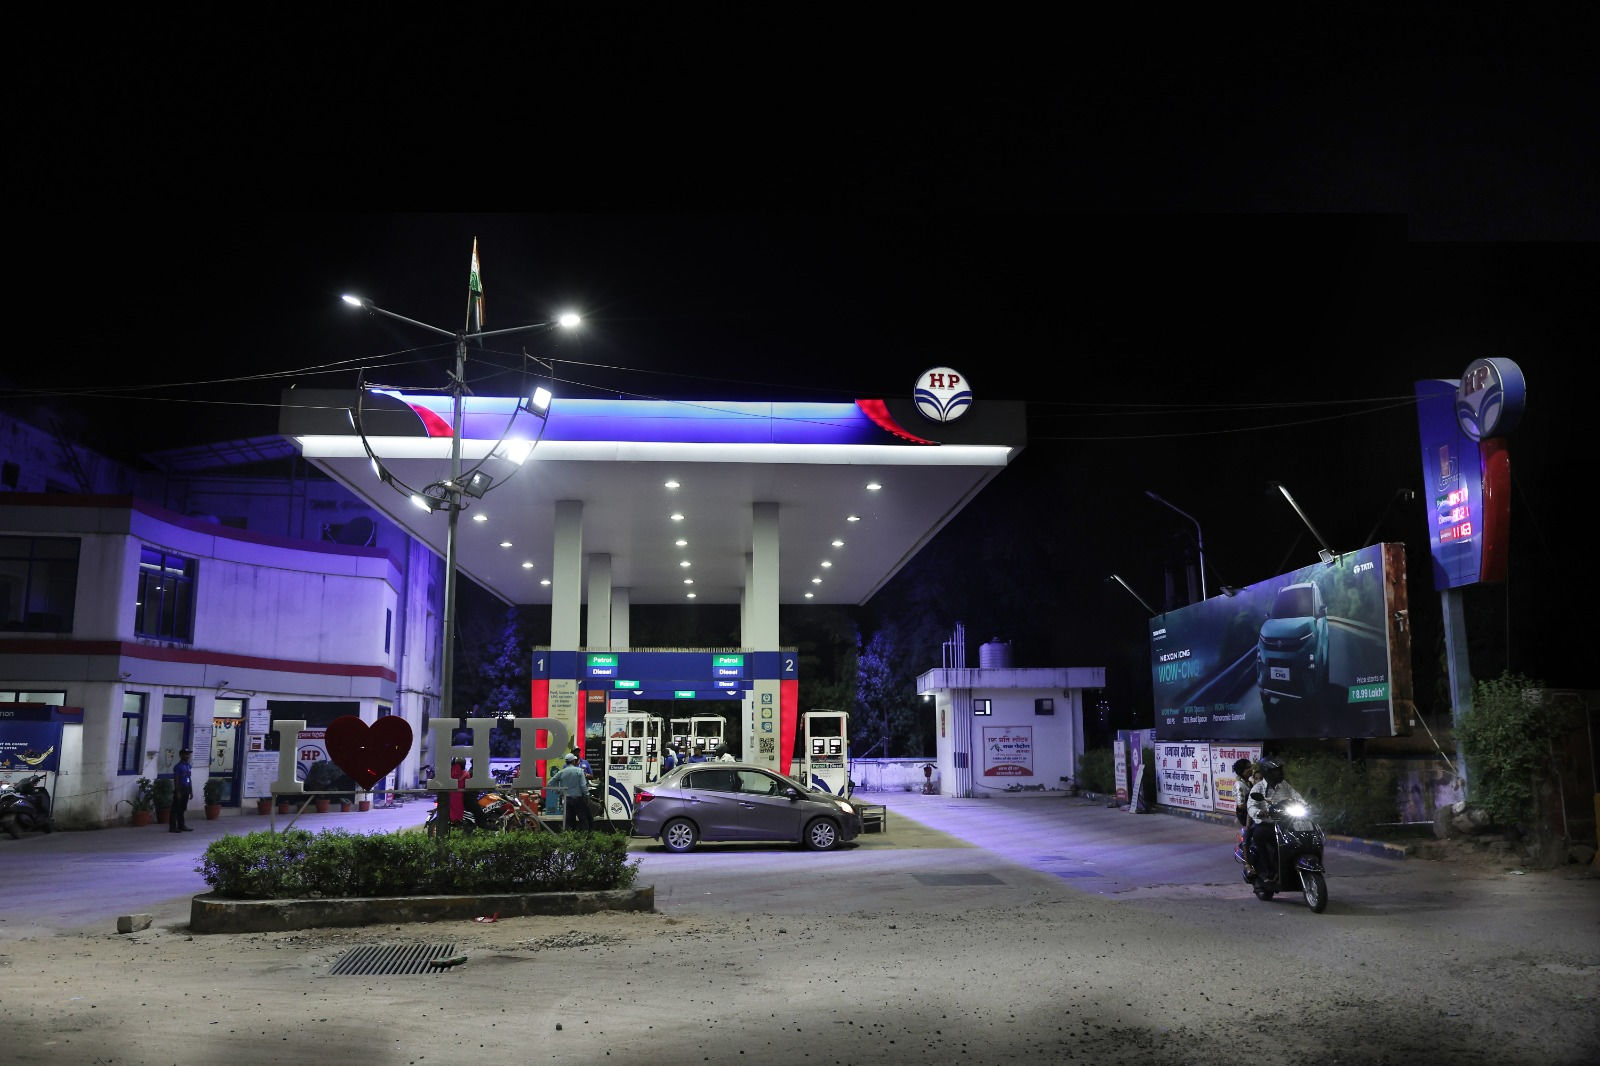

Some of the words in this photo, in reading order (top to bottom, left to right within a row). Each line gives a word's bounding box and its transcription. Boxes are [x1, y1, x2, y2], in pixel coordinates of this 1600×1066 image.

[929, 373, 961, 390] HP
[1463, 365, 1490, 397] HP
[1360, 562, 1374, 571] TATA
[1160, 652, 1177, 662] NEXON
[537, 658, 544, 672] 1
[785, 659, 794, 672] 2
[271, 719, 306, 793] I
[301, 750, 321, 761] HP
